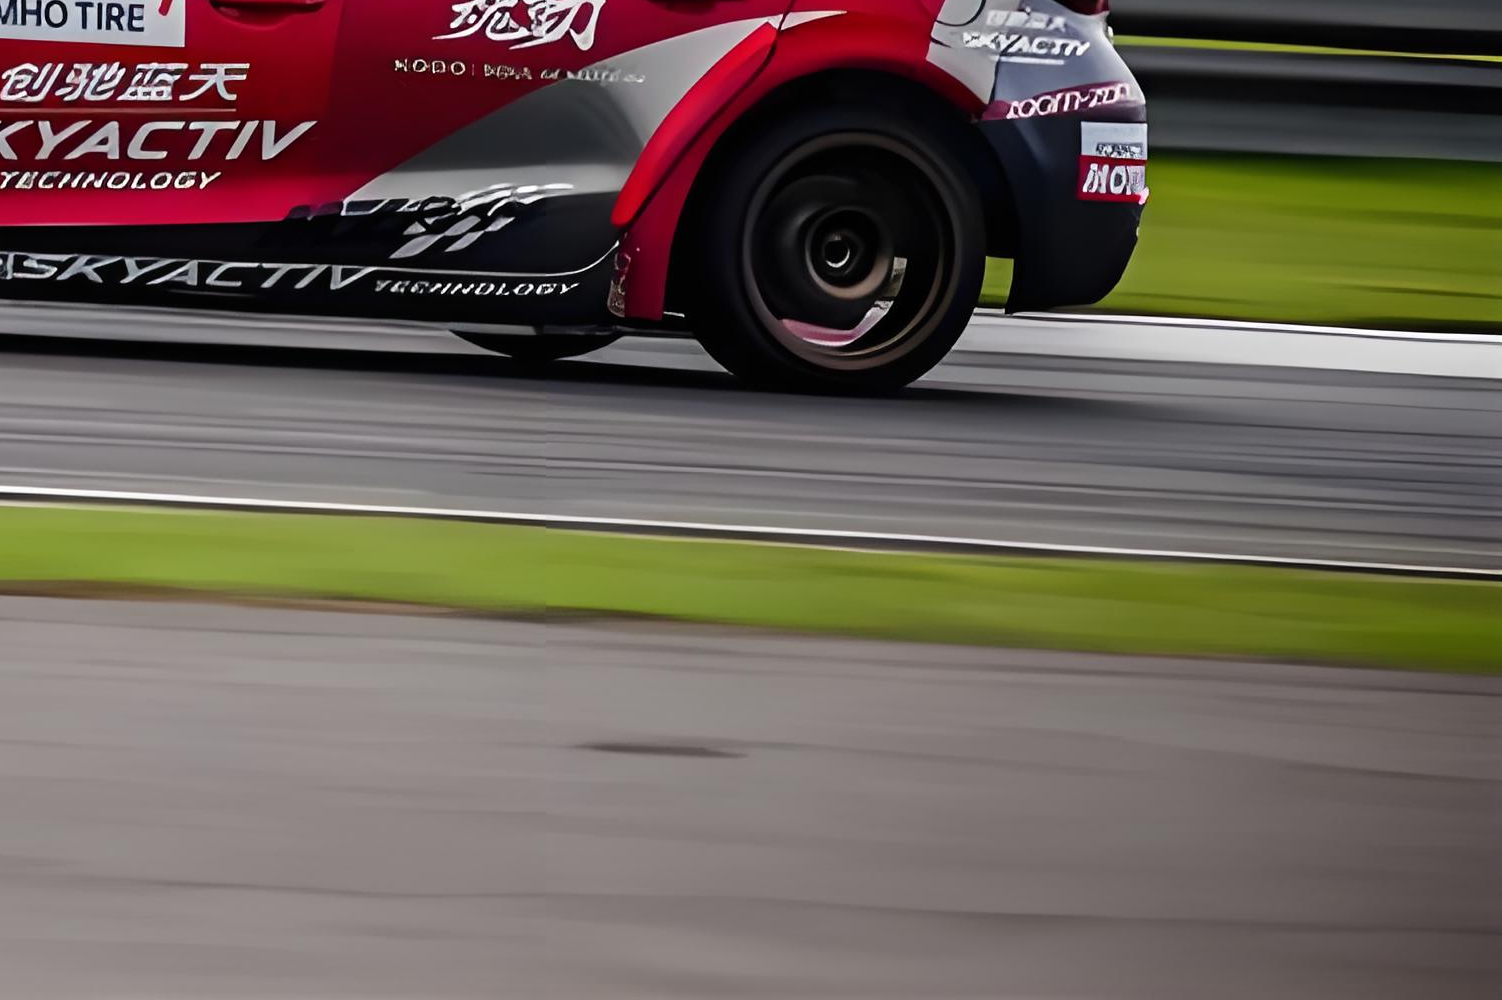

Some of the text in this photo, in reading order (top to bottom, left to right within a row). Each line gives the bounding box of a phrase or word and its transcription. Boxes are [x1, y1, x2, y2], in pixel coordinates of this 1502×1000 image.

[74, 1, 145, 34] TIRE
[0, 62, 250, 102] 创驰蓝天
[12, 252, 377, 291] SKYACTIV
[374, 278, 581, 297] TECHNOLOGY
